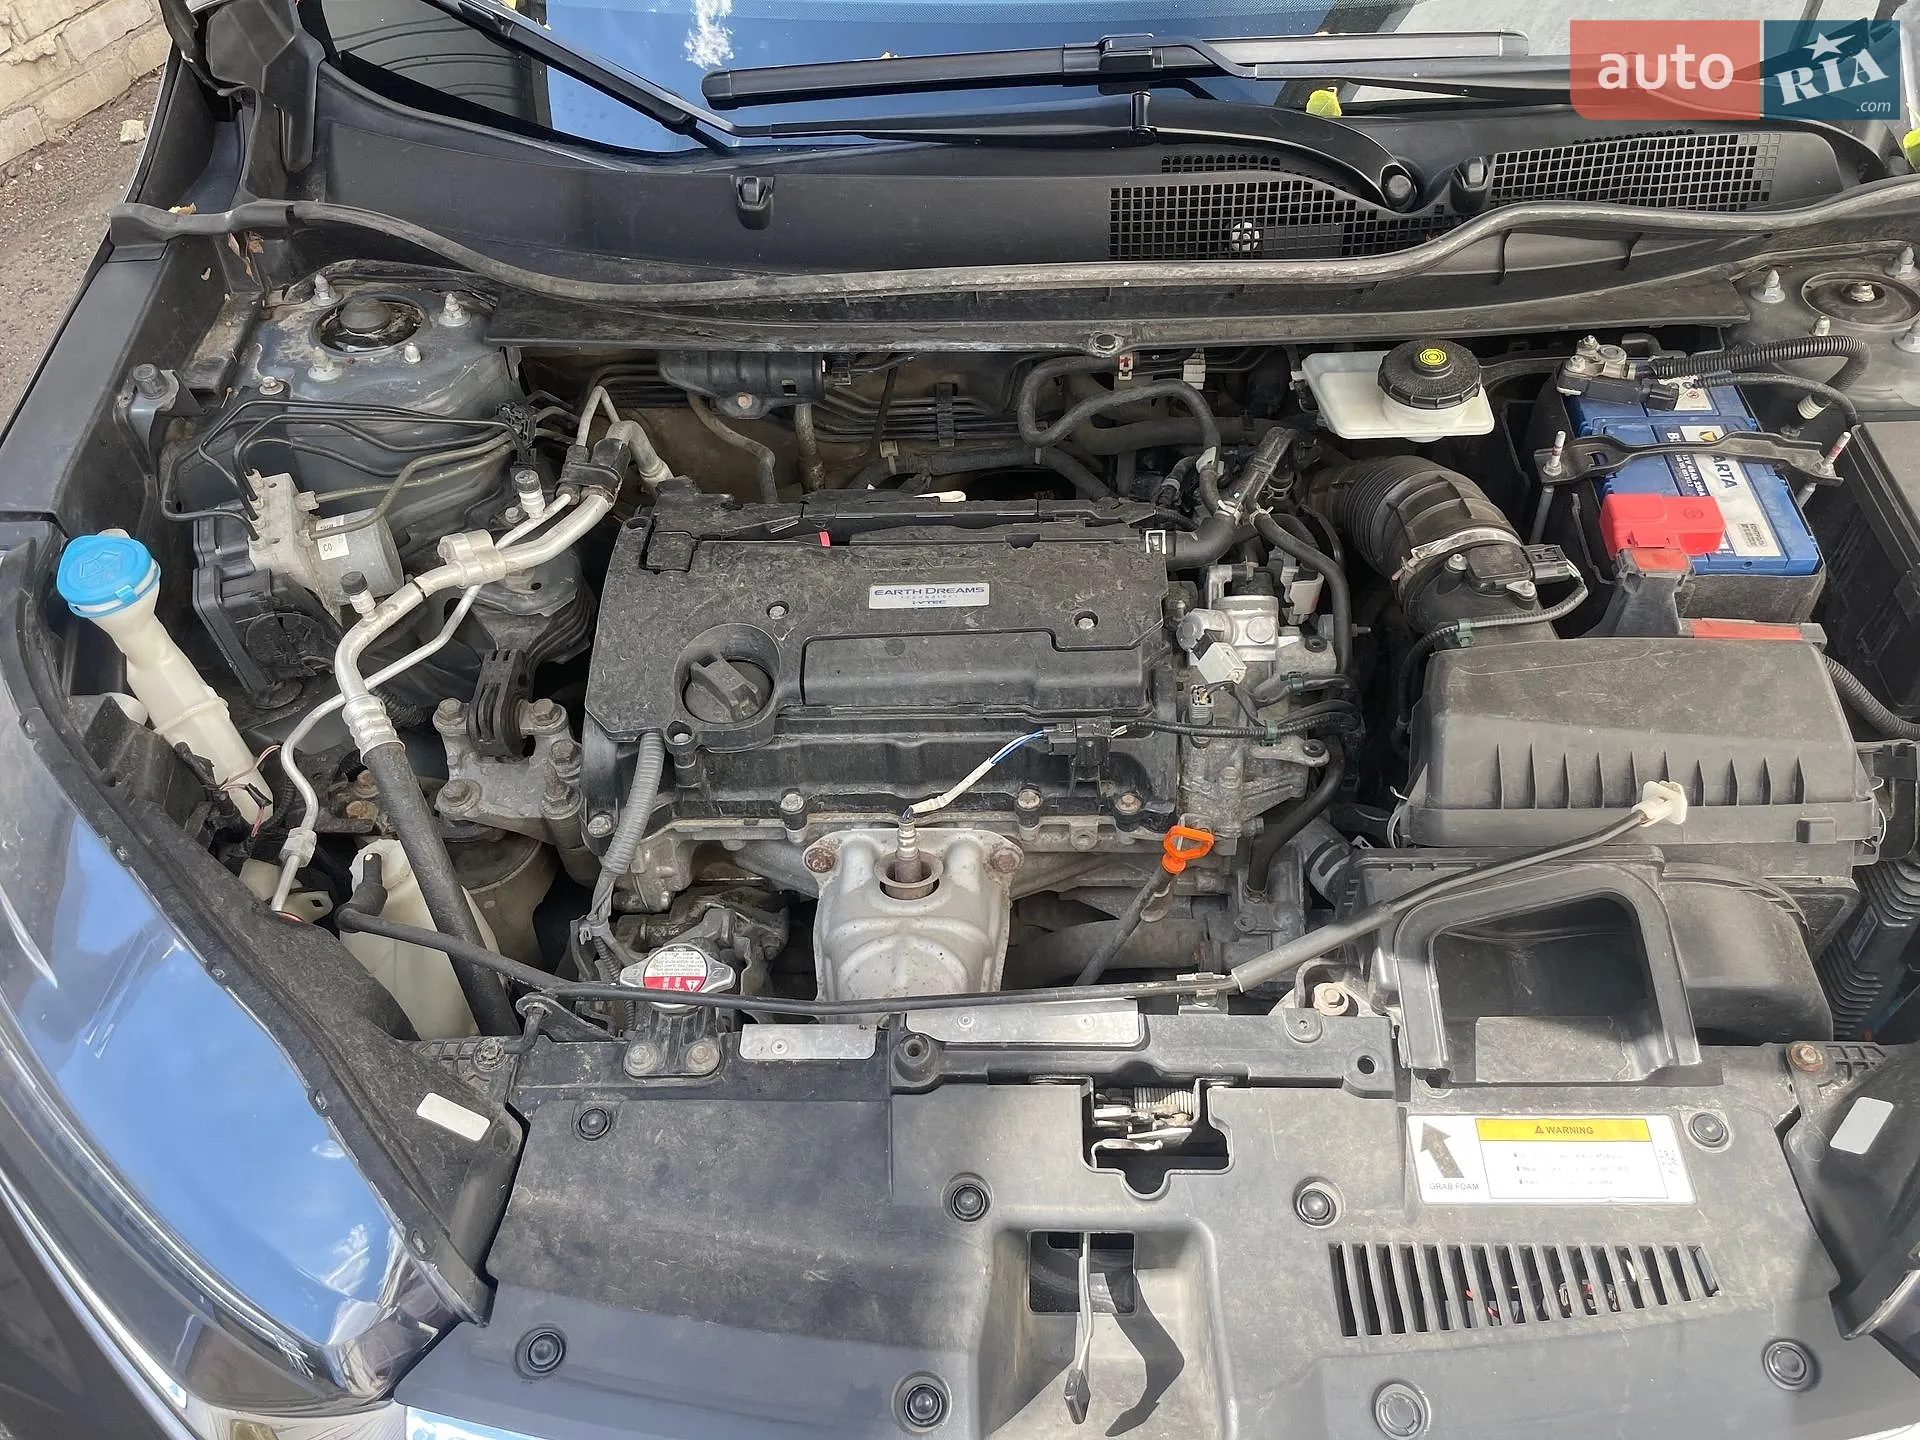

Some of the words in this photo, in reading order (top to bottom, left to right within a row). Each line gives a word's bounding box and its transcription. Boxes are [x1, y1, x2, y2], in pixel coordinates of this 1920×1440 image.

[874, 587, 922, 596] EARTH
[925, 586, 985, 595] DREAMS
[1545, 1126, 1594, 1135] WARNING
